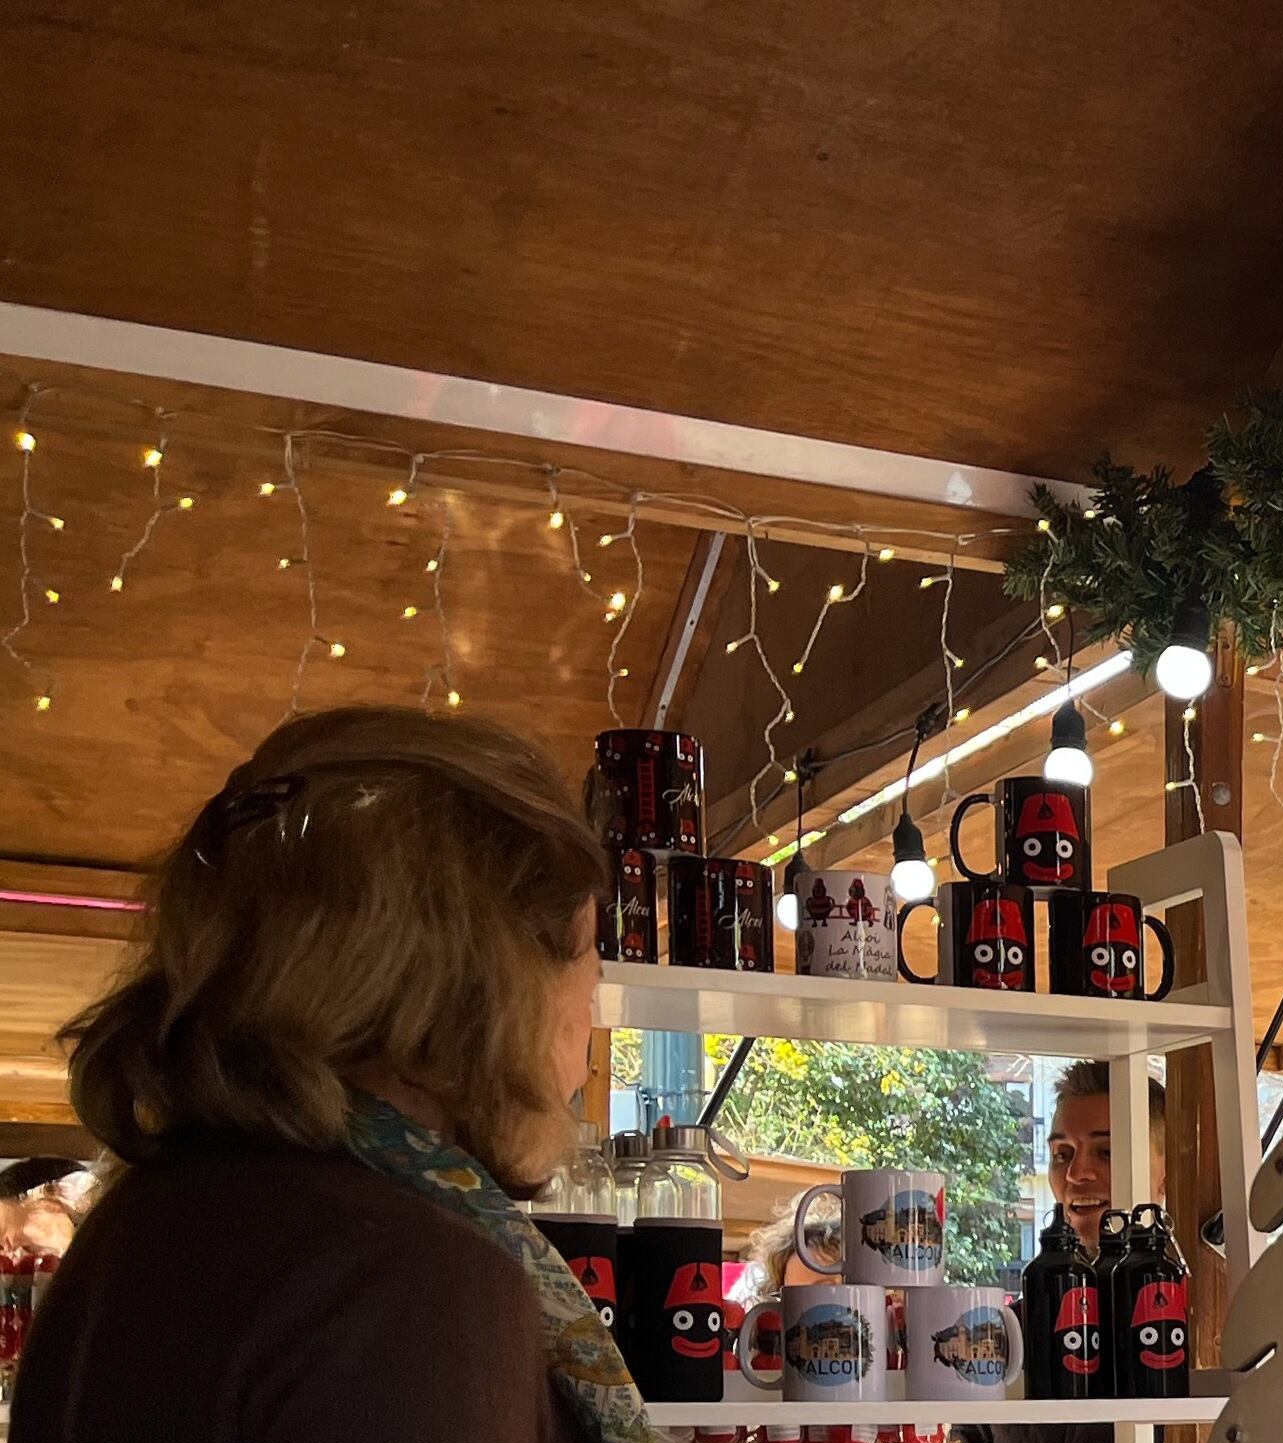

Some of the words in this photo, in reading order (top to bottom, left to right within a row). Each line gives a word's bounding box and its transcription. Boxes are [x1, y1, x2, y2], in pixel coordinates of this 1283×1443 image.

[841, 930, 881, 943] Aloi
[828, 944, 847, 956] La
[825, 960, 850, 973] del
[893, 1244, 938, 1261] ALCOI
[806, 1360, 858, 1376] ALCOI
